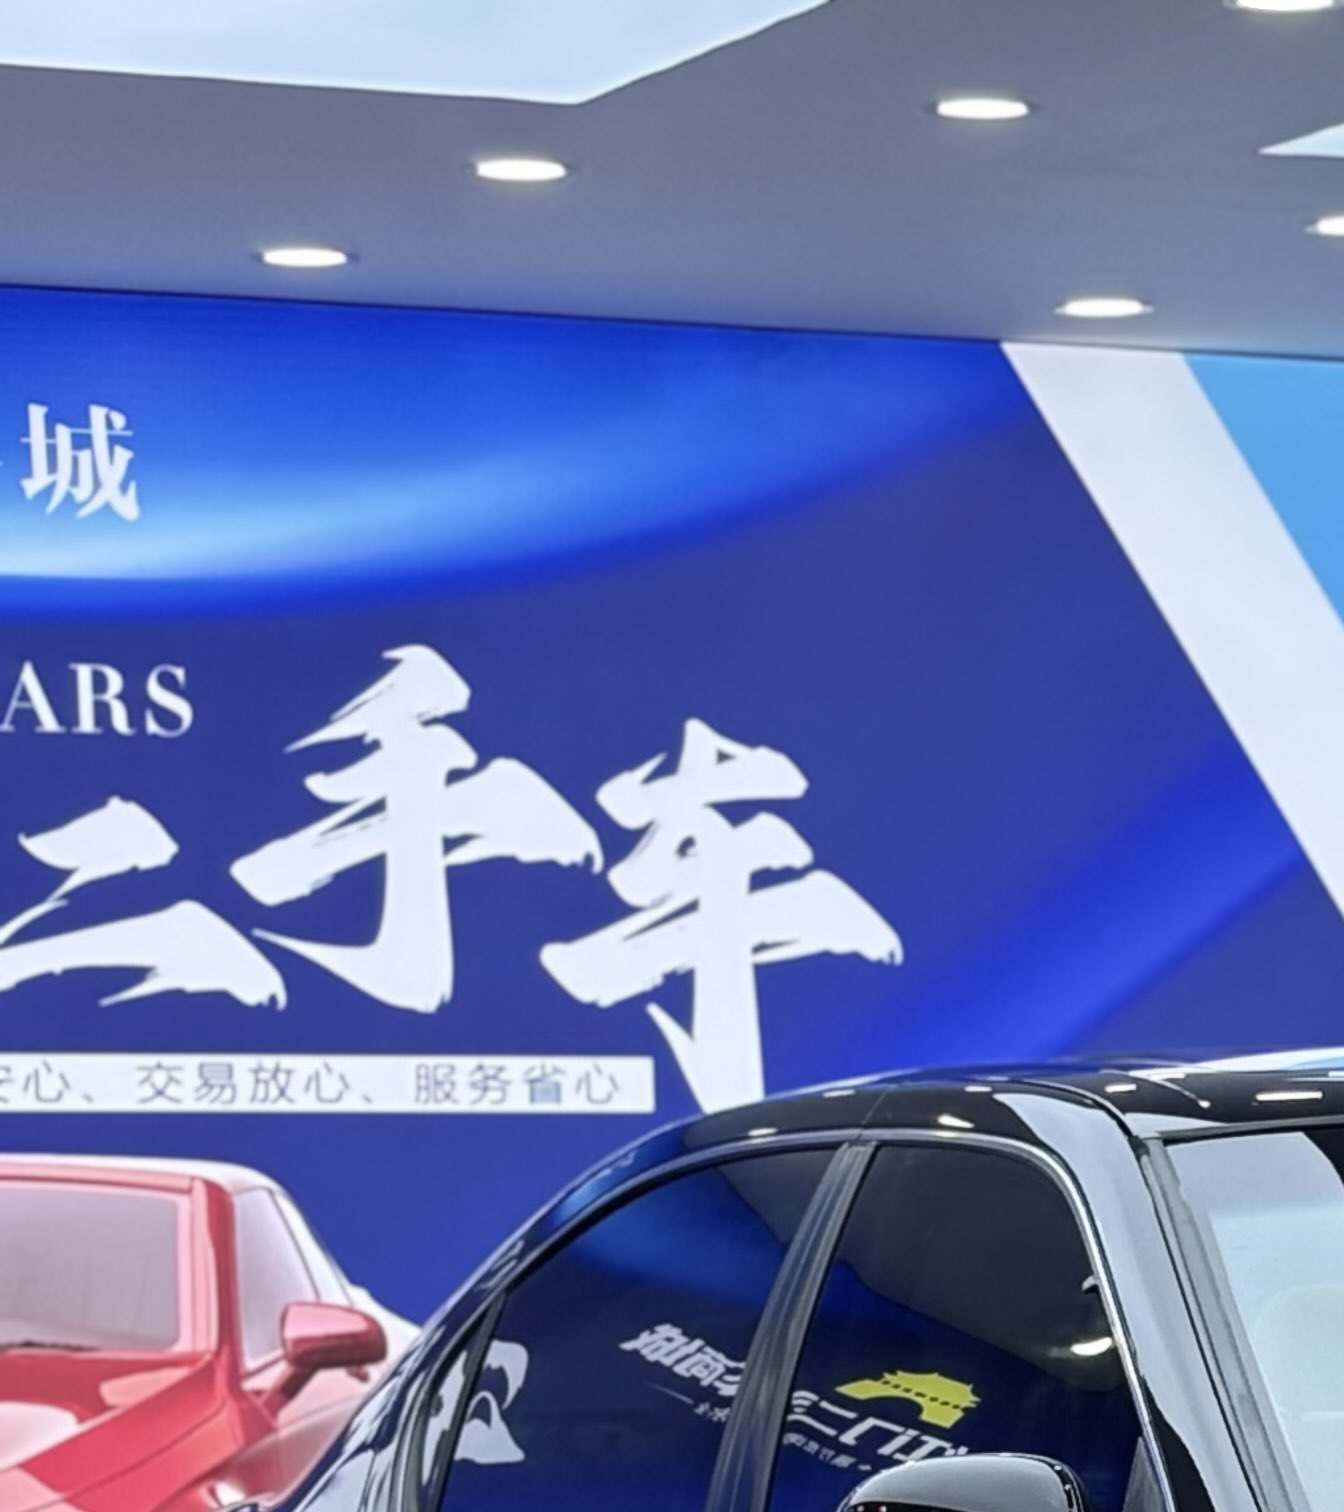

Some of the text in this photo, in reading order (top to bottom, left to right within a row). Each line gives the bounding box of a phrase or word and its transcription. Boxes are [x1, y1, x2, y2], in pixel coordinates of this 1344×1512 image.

[19, 401, 141, 522] 城
[0, 1060, 621, 1107] 心、交易放心、服务省心
